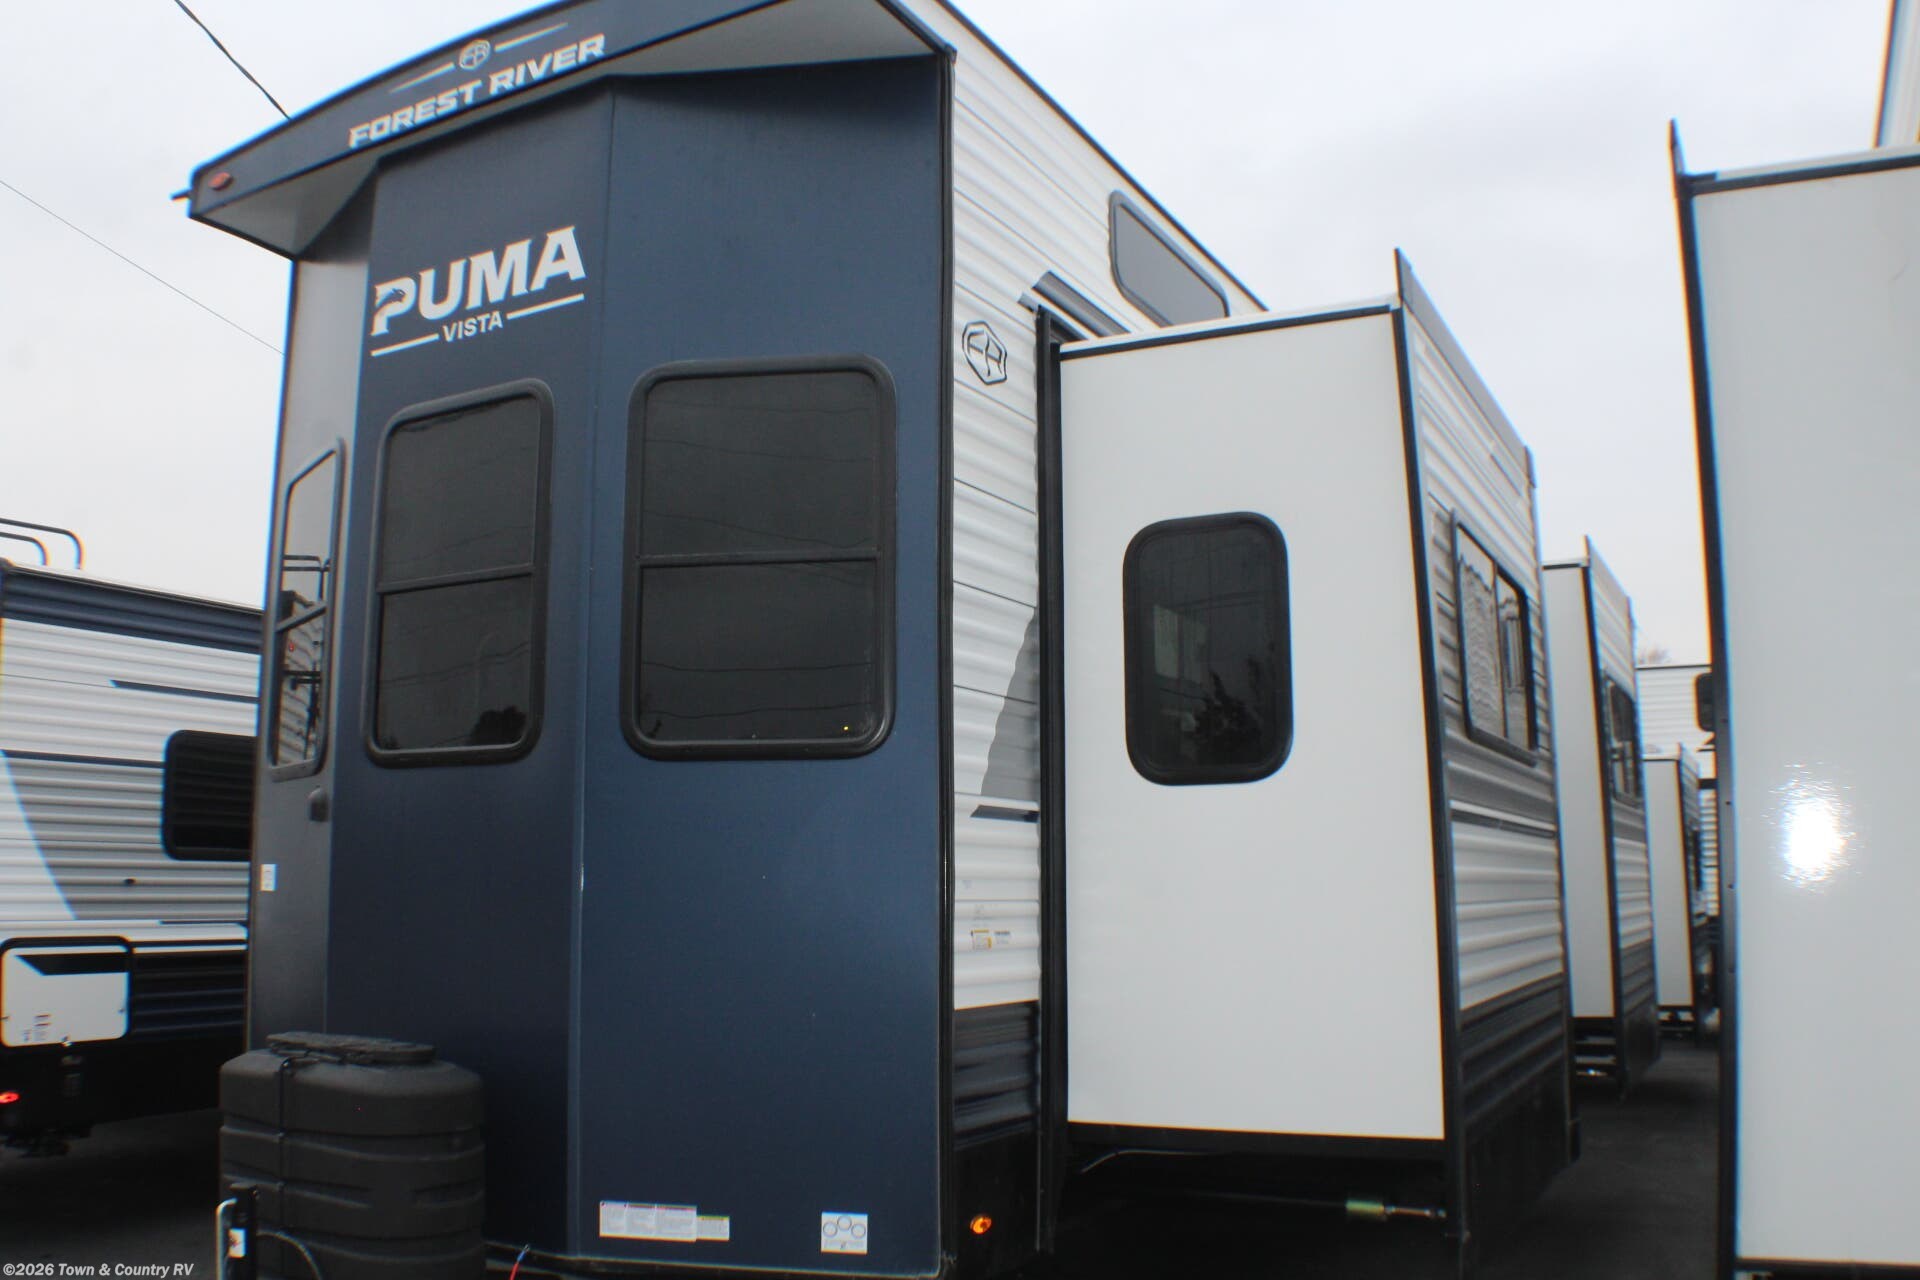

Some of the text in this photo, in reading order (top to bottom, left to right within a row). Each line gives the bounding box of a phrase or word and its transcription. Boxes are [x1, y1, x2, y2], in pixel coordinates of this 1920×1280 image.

[348, 33, 605, 148] FOREST RIVER
[371, 225, 587, 336] PUMA
[442, 311, 503, 342] VISTA
